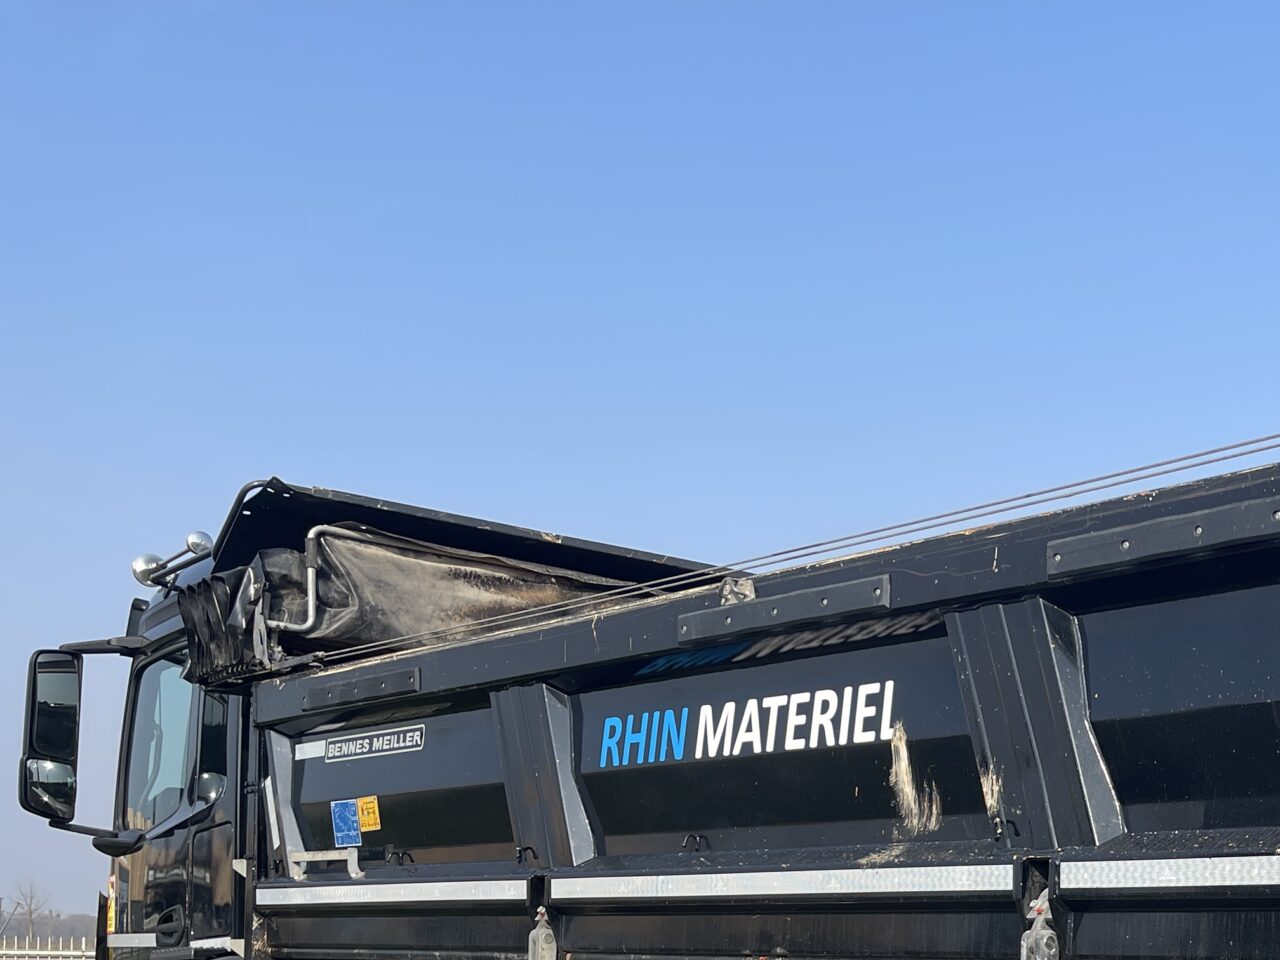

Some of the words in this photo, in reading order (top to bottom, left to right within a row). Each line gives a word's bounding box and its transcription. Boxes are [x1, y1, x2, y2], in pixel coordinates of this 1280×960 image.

[327, 738, 369, 757] BENNES
[372, 730, 421, 751] MEILLER
[599, 706, 689, 768] RHIN
[695, 679, 895, 760] MATERIEL
